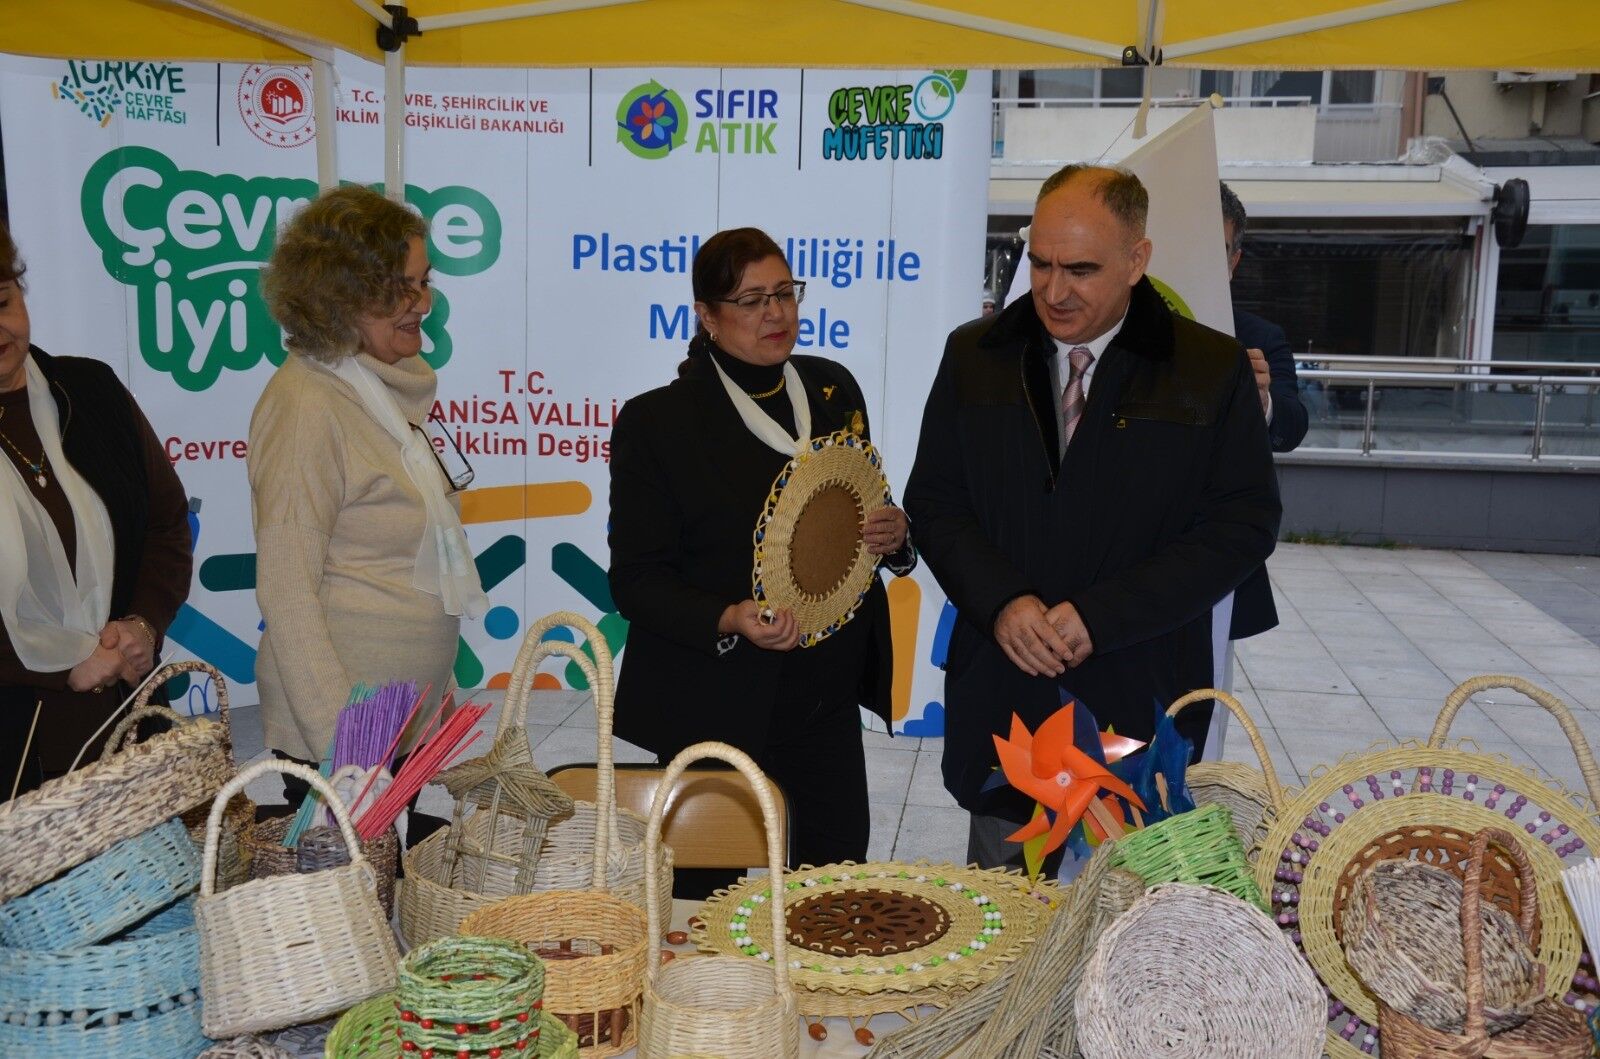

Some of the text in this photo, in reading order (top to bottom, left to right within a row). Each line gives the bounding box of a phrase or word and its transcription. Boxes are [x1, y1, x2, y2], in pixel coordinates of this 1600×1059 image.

[125, 91, 174, 110] ÇEVRE
[125, 105, 187, 124] HAFTASI
[351, 89, 380, 104] T.C.
[442, 94, 525, 112] ŞEHİRCİLİK
[529, 100, 548, 113] VE
[695, 89, 778, 119] SIFIR
[828, 84, 914, 128] ÇEVRE
[336, 106, 564, 134] İKLİM ĞİŞİKLİĞİ BAKANLIĞI
[694, 122, 778, 154] ATIK
[786, 237, 864, 288] liliği
[876, 239, 920, 281] ile
[498, 370, 553, 395] T.C.
[427, 394, 620, 428] ANİSA VALİLİ
[164, 436, 248, 468] Çevre
[456, 425, 527, 456] İklim
[538, 433, 611, 464] Değiş
